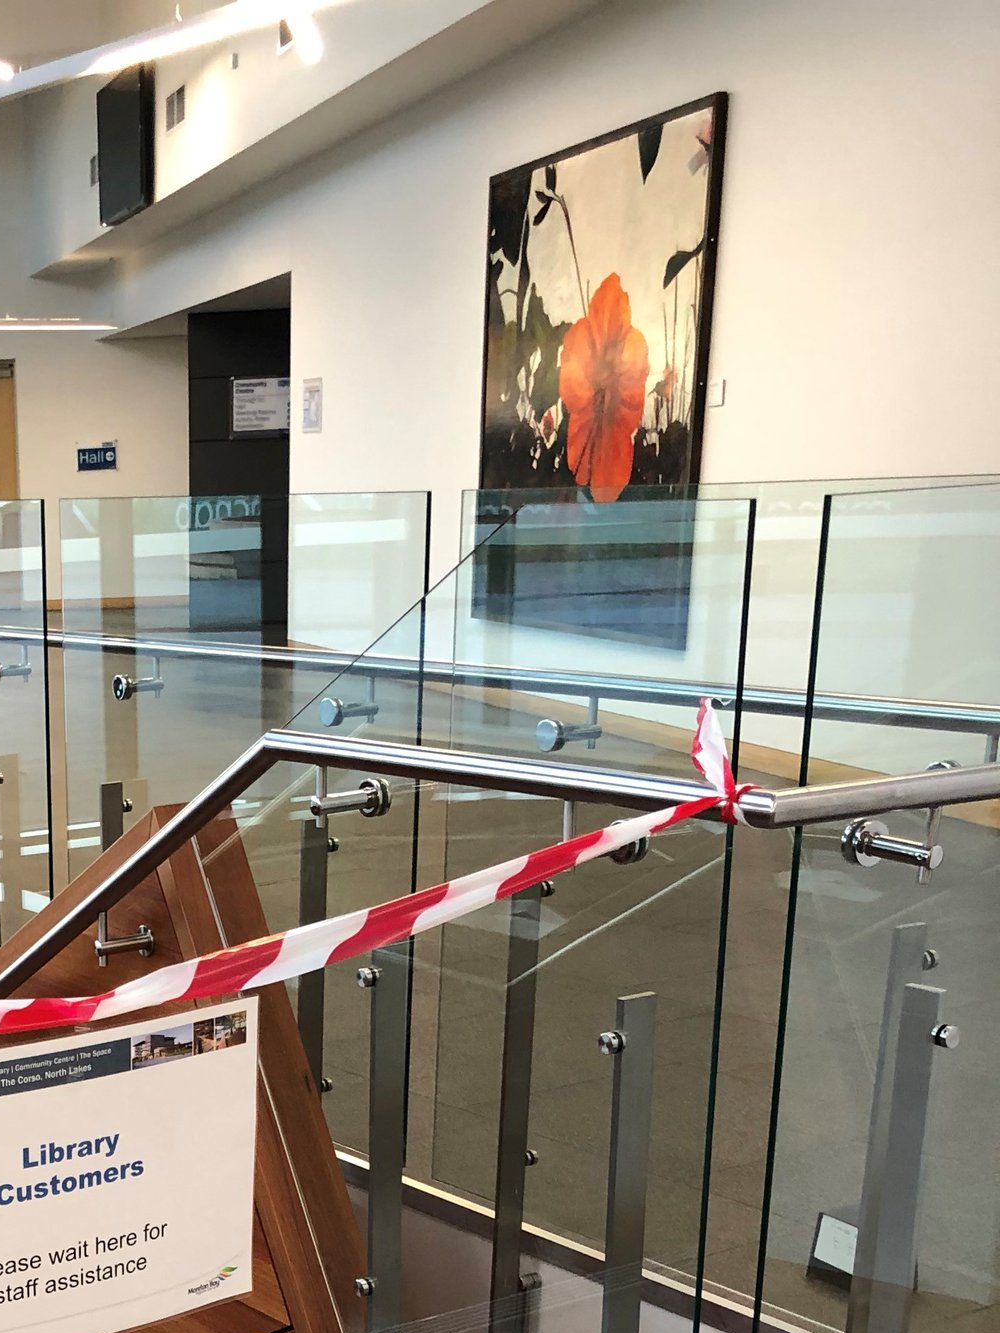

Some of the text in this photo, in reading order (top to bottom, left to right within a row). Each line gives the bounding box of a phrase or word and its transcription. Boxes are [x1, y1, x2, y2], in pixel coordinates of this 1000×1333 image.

[80, 450, 104, 464] Hall
[14, 1060, 53, 1072] Community
[53, 1055, 75, 1065] Centre
[79, 1052, 92, 1060] The
[92, 1048, 112, 1058] Space
[0, 1078, 16, 1088] The
[44, 1068, 67, 1080] North
[68, 1063, 92, 1075] Lakes
[22, 1133, 120, 1169] Library
[48, 1241, 89, 1265] wait
[95, 1231, 138, 1255] here
[143, 1222, 169, 1243] for
[45, 1256, 148, 1294] assistance
